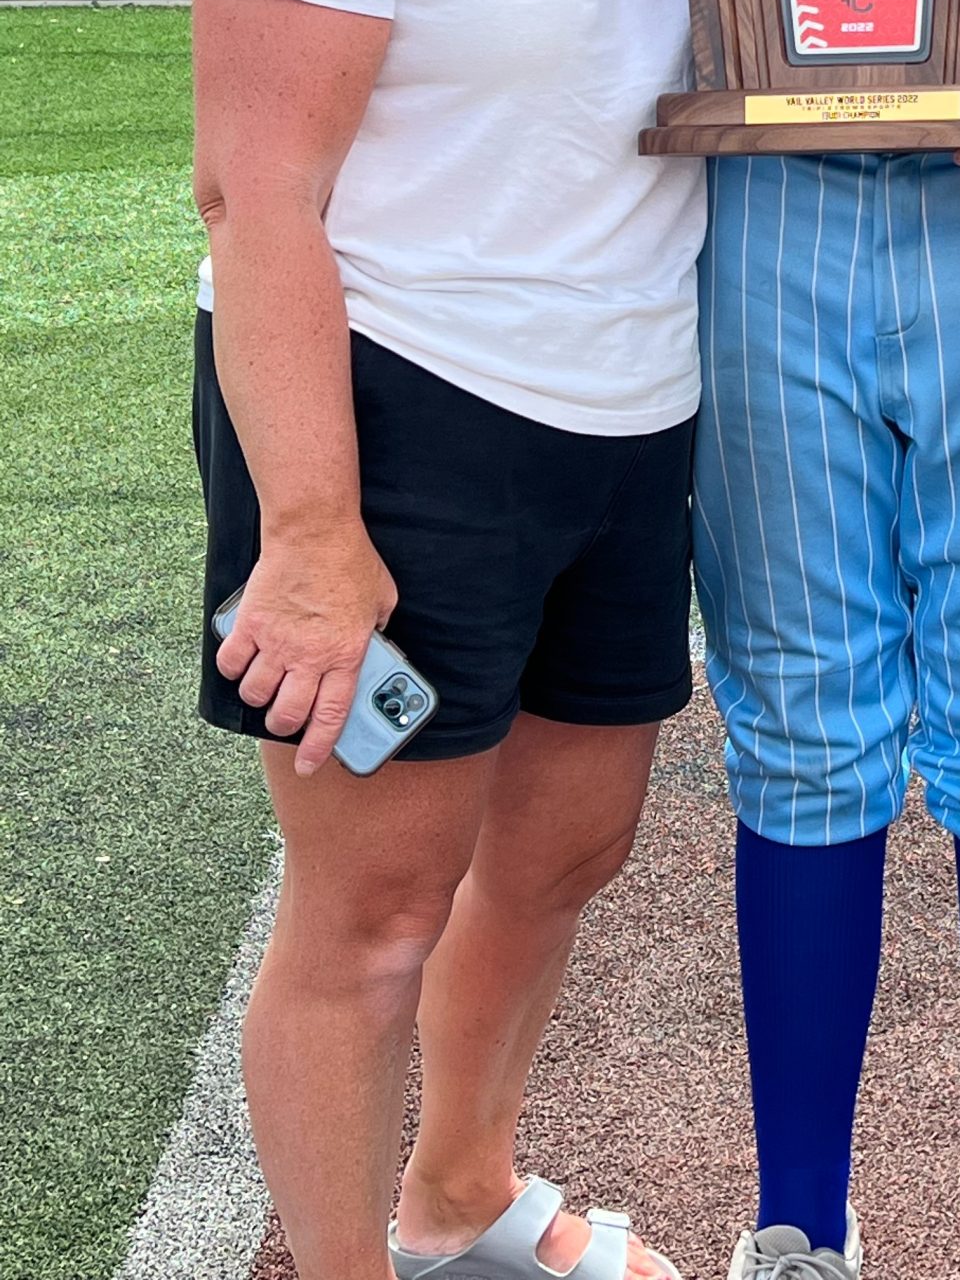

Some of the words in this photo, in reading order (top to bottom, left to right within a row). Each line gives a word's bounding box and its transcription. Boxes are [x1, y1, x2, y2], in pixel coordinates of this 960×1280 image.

[840, 22, 875, 33] 2022
[786, 96, 803, 106] VAIL
[806, 96, 834, 106] VALLEY
[837, 95, 865, 105] WORLD
[867, 95, 895, 104] SERIES
[897, 94, 919, 104] 2022
